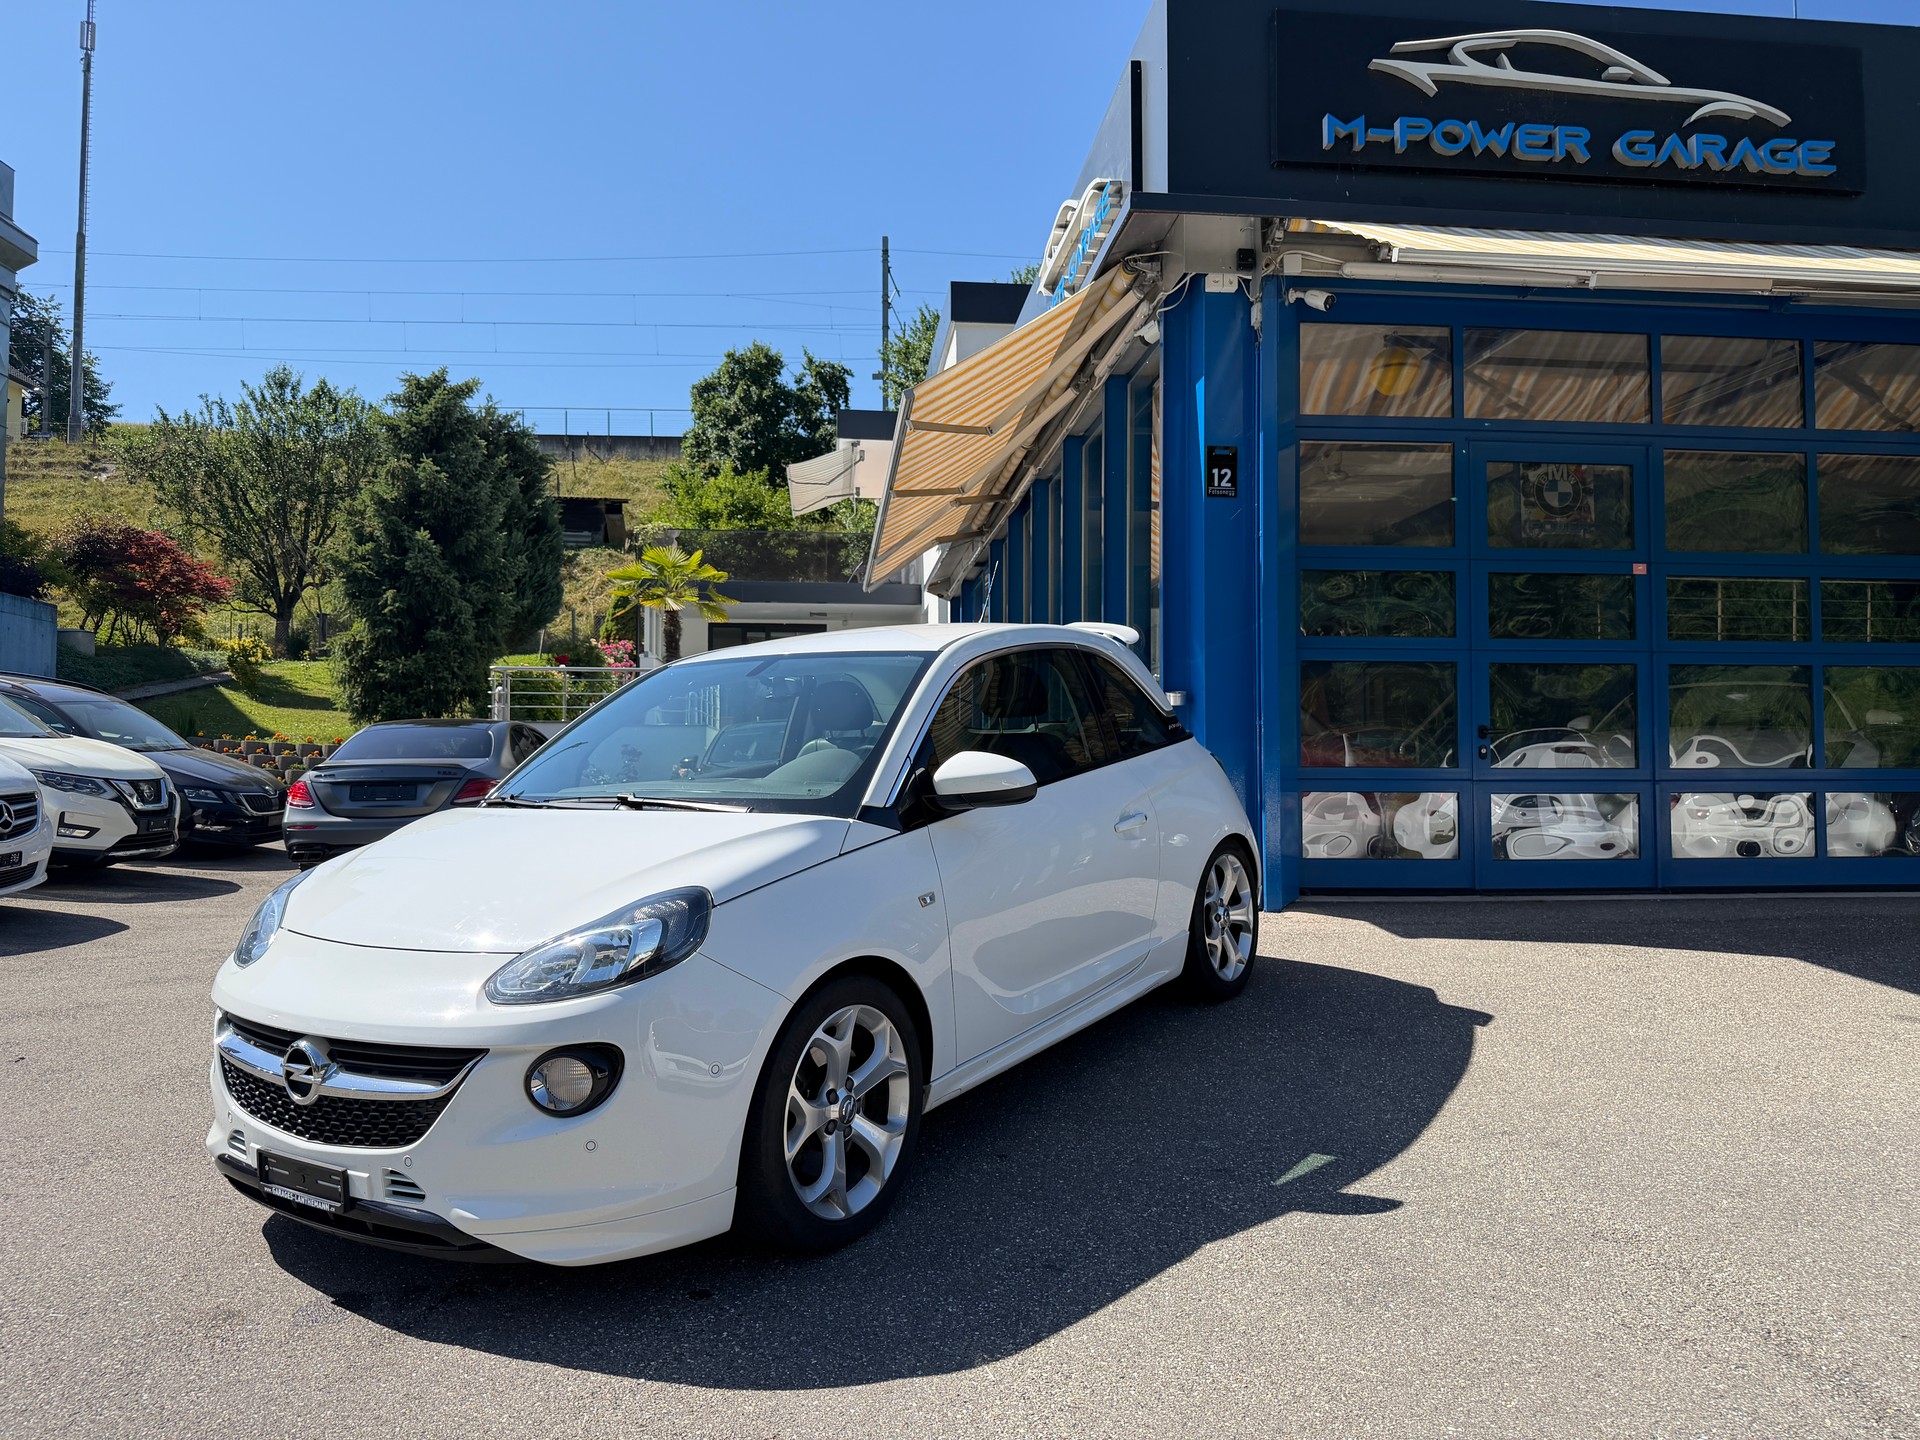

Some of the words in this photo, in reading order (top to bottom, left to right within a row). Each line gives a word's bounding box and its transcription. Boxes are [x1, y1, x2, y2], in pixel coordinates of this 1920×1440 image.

[1322, 113, 1591, 164] M-POWER
[1612, 130, 1837, 177] GARAGE
[1212, 468, 1232, 487] 12
